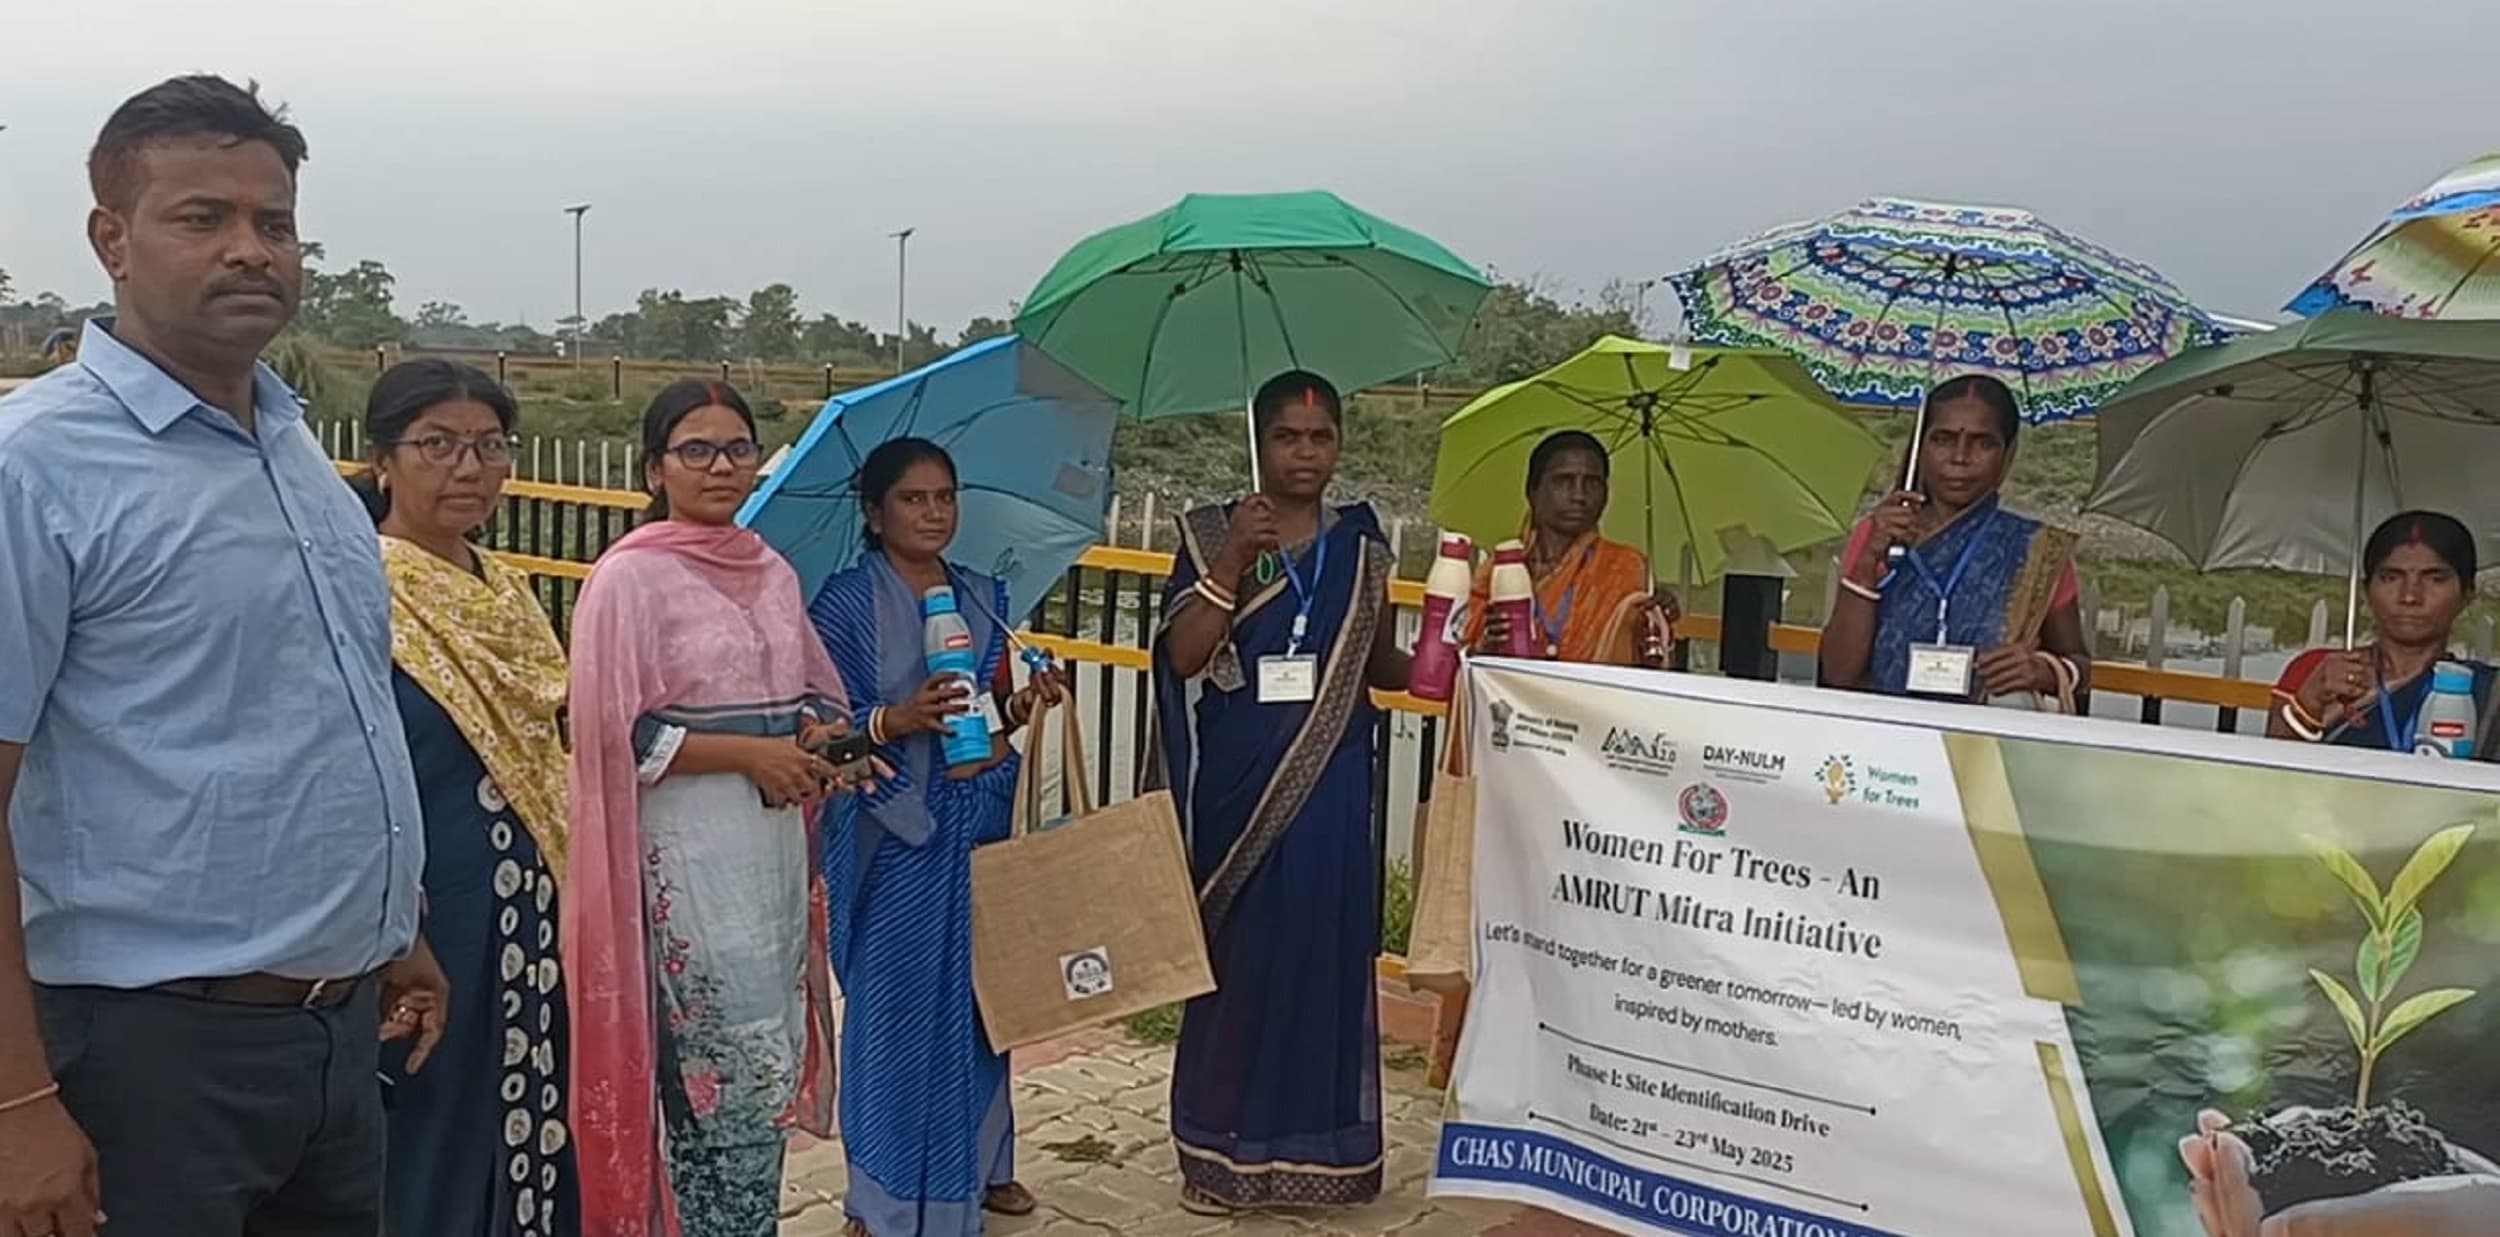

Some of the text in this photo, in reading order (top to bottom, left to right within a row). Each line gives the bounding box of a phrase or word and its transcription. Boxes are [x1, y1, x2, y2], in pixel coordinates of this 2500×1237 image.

[1703, 744, 1786, 772] DAY-NULM
[1868, 766, 1919, 787] Women
[1863, 786, 1920, 810] for Trees
[1563, 819, 1664, 866] Women
[1672, 839, 1722, 875] For
[1731, 847, 1811, 889] Trees
[1837, 867, 1880, 900] An
[1552, 873, 1882, 959] AMRUT Mitra Initiative
[1558, 943, 1618, 969] together
[1621, 956, 1643, 977] for
[1646, 965, 1658, 980] a
[1659, 968, 1722, 994] greener
[1832, 997, 1860, 1020] led
[1864, 1001, 1889, 1031] by
[1891, 1010, 1963, 1042] women,
[1614, 993, 1779, 1047] inspired by mothers.
[1567, 1053, 1608, 1086] Phase
[1625, 1073, 1659, 1097] Site
[1661, 1080, 1776, 1127] Identification
[1781, 1109, 1831, 1138] Drive
[1451, 1136, 1516, 1170] CHAS
[1518, 1143, 1648, 1209] MUNICIPAL
[1590, 1102, 1629, 1133] Date:
[1711, 1135, 1746, 1167] May
[1750, 1146, 1794, 1174] 2025
